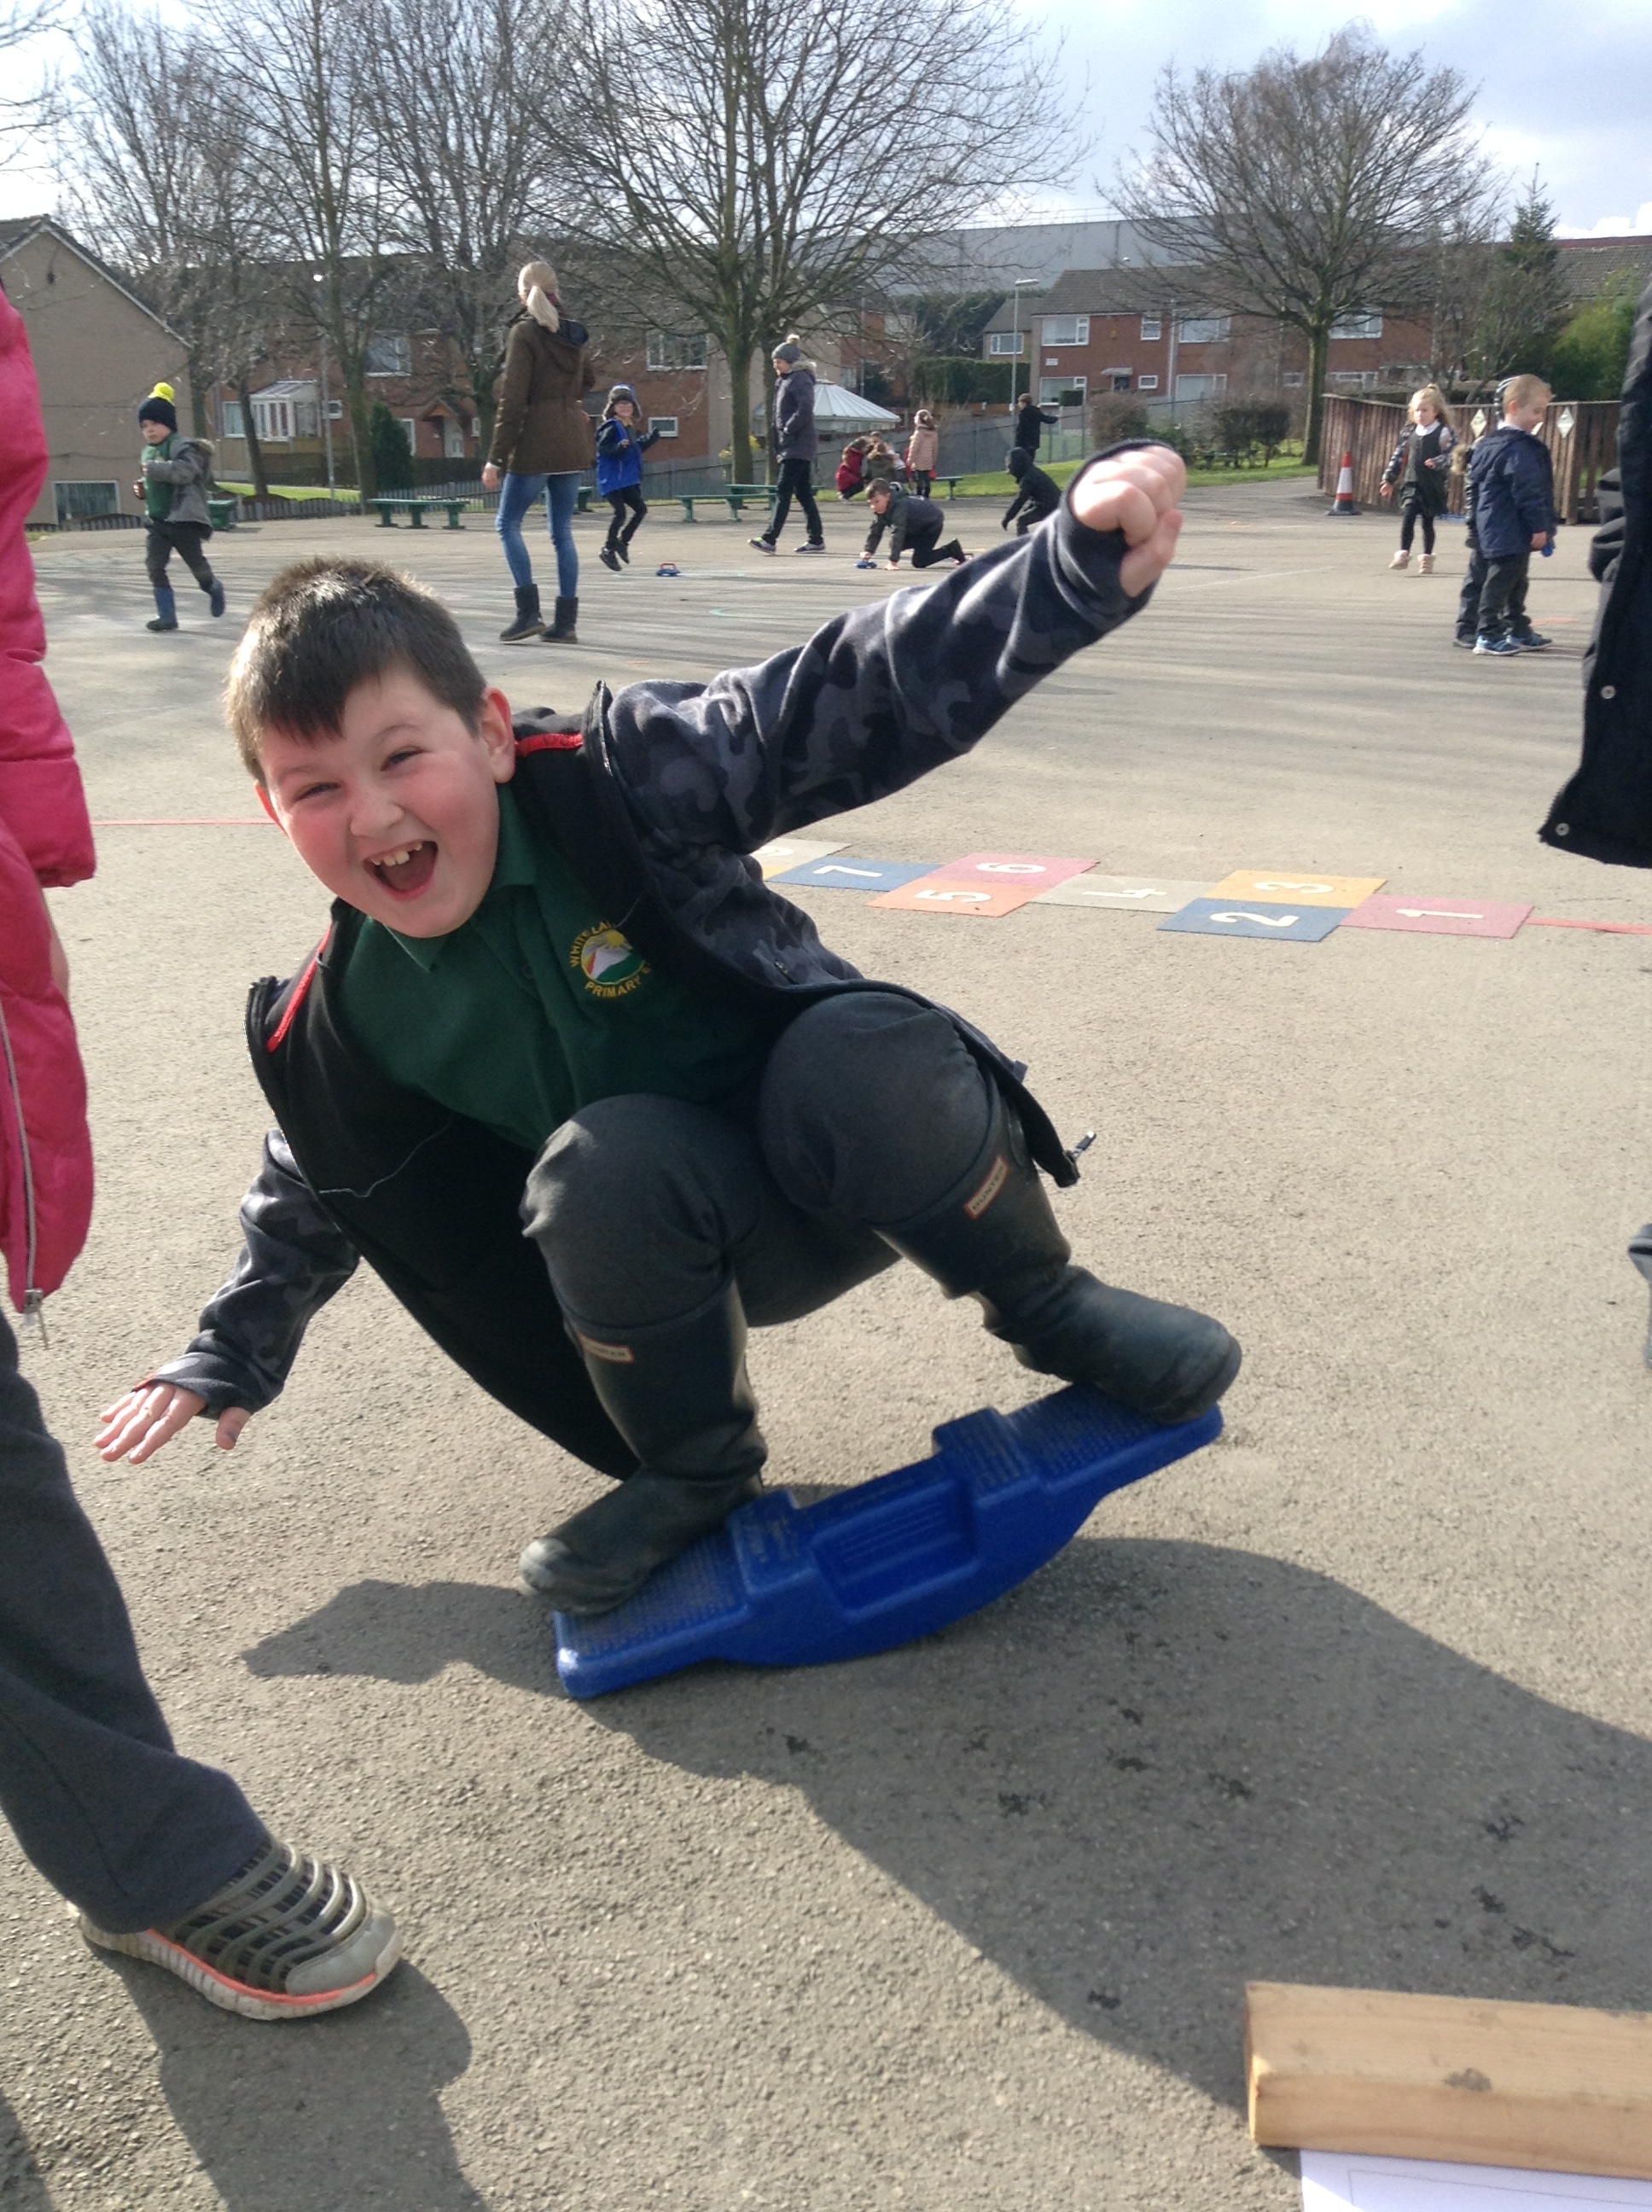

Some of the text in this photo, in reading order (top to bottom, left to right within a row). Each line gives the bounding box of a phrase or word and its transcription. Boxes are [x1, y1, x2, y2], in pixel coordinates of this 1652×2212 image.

[813, 865, 882, 877] 7
[975, 863, 1046, 873] 6
[1081, 888, 1167, 899] 4
[1254, 882, 1333, 894] 3
[914, 889, 992, 903] 5
[1210, 912, 1299, 927] 2
[1396, 909, 1484, 918] 1
[585, 975, 641, 997] PRIMARY
